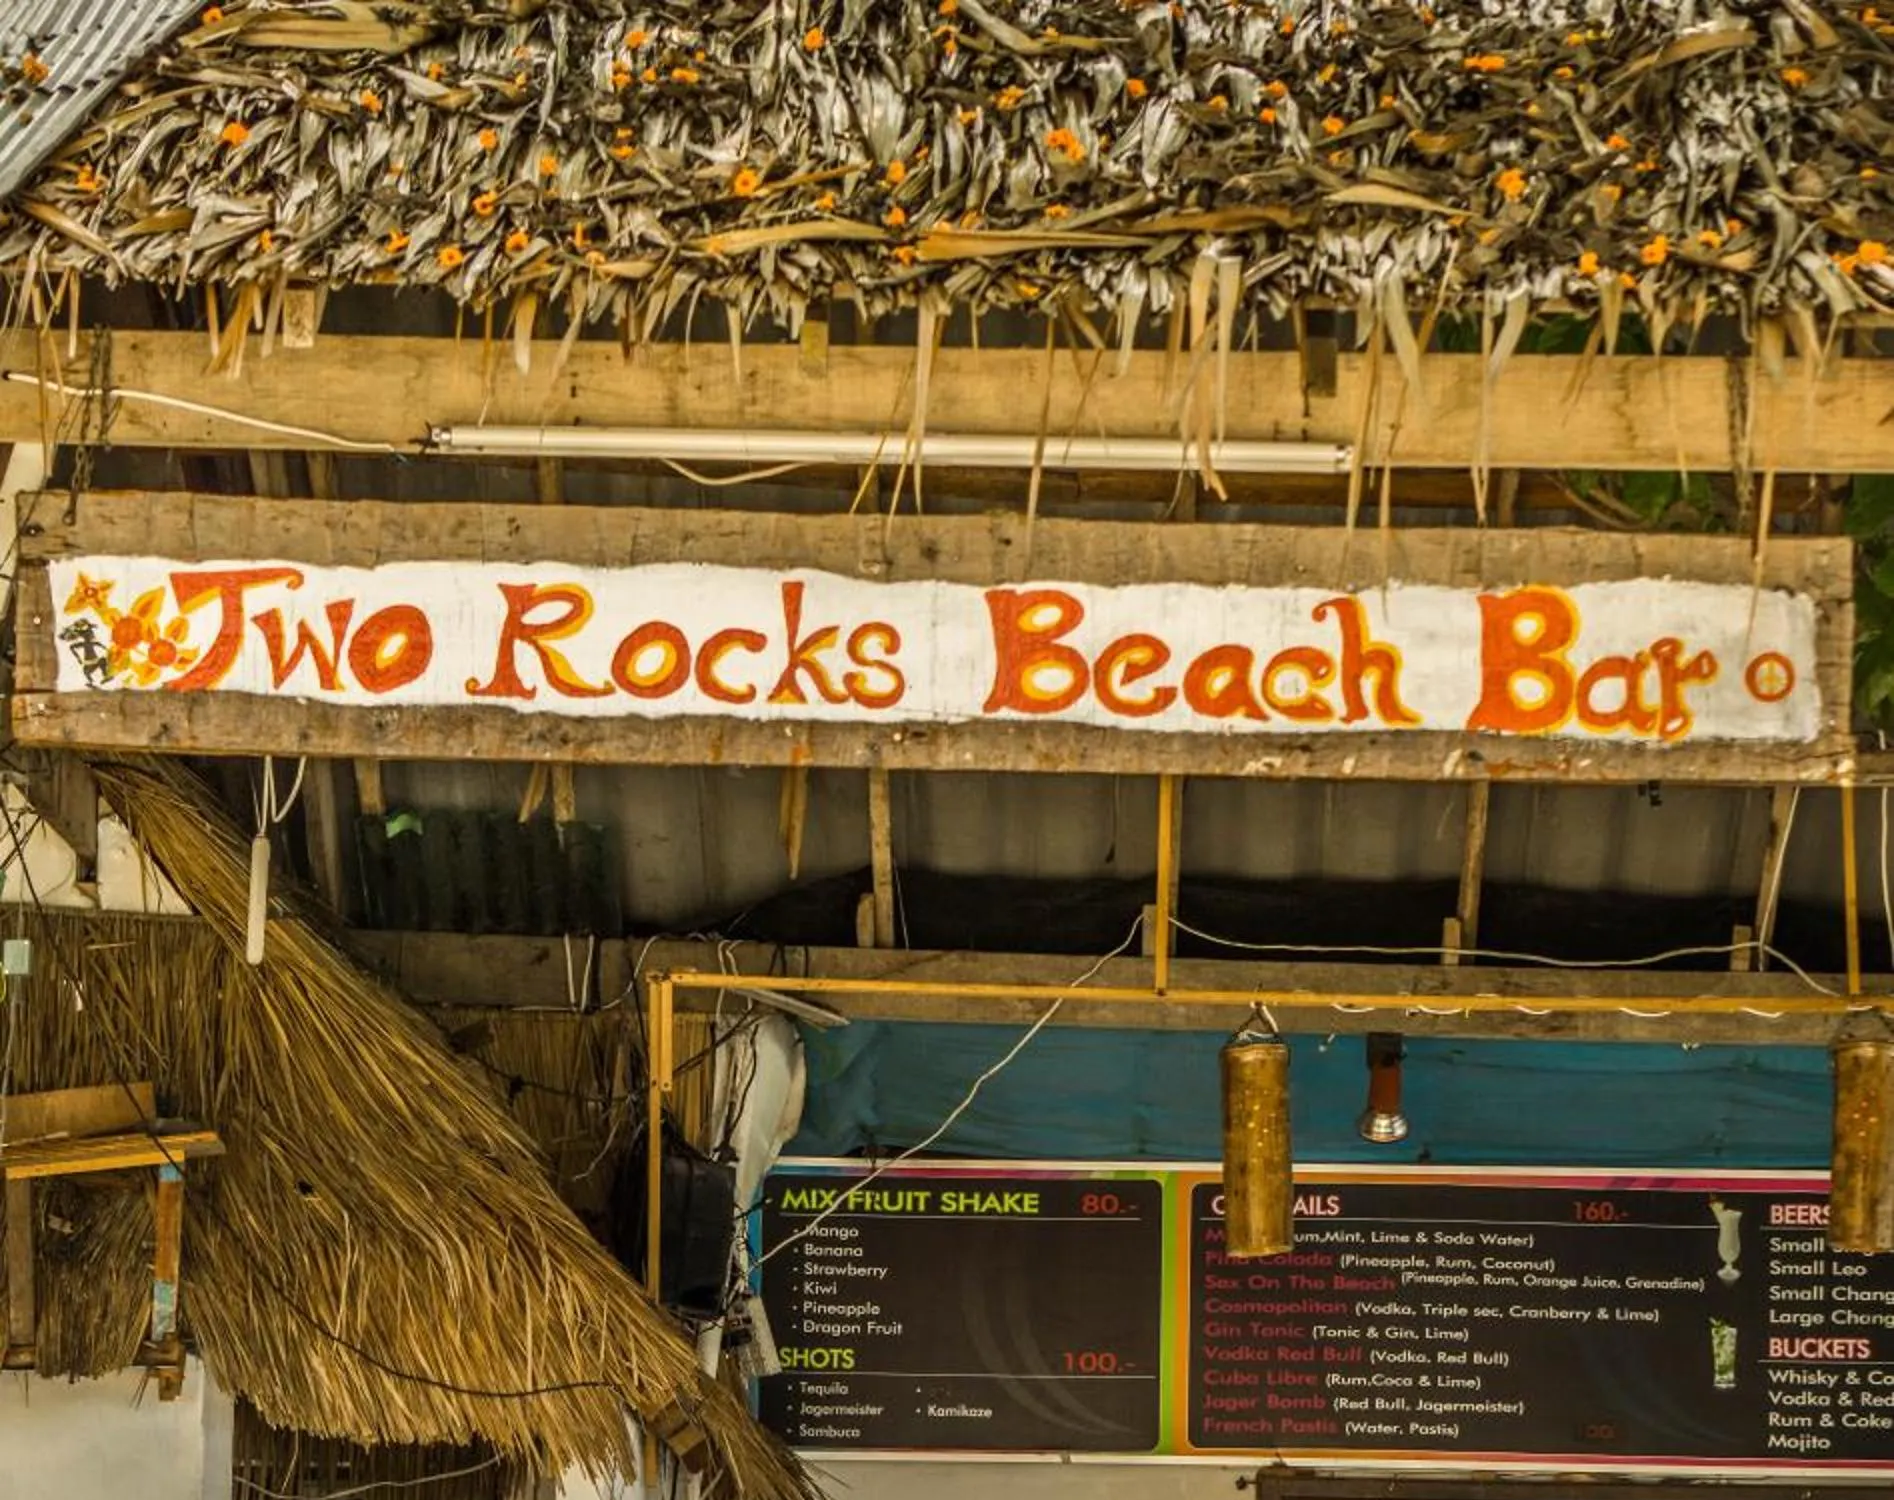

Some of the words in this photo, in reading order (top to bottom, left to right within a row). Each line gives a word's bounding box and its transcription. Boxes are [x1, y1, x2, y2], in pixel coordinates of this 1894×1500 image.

[163, 568, 434, 694] Two
[465, 581, 906, 709] Rocks
[982, 589, 1424, 727] Beach
[1466, 585, 1719, 742] Bar
[781, 1189, 838, 1209] MIX
[847, 1191, 931, 1212] FRUIT
[940, 1192, 1039, 1213] SHAKE
[1211, 1196, 1340, 1215] CAILS
[1770, 1204, 1831, 1225] BEERS
[804, 1226, 859, 1240] Mango
[1371, 1231, 1409, 1243] Lime
[1416, 1231, 1428, 1244] &
[1433, 1232, 1474, 1245] Soda
[1479, 1233, 1535, 1248] Water)
[804, 1243, 864, 1257] Banana
[1769, 1237, 1824, 1253] Small
[803, 1261, 888, 1280] Strawberry
[1482, 1257, 1555, 1272] Coconut)
[1769, 1260, 1824, 1275] Small
[1832, 1261, 1868, 1276] Leo
[803, 1282, 837, 1295] Kiwi
[1205, 1275, 1238, 1289] Sex
[1249, 1275, 1280, 1289] On
[1289, 1275, 1325, 1290] The
[1334, 1275, 1395, 1290] Beach
[1523, 1274, 1577, 1289] Orange
[1625, 1277, 1705, 1292] Grenadine)
[1769, 1285, 1824, 1300] Small
[1831, 1285, 1894, 1304] Chang
[803, 1301, 880, 1316] Pineapple
[1423, 1303, 1468, 1318] Triple
[1509, 1305, 1591, 1321] Cranberry
[1597, 1308, 1609, 1320] &
[1615, 1307, 1660, 1323] Lime)
[1769, 1309, 1824, 1327] Large
[1831, 1309, 1894, 1328] Chang
[803, 1320, 861, 1337] Dragon
[867, 1321, 903, 1335] Fruit
[1204, 1322, 1241, 1337] Gin
[1250, 1322, 1306, 1337] Tonic
[1312, 1325, 1361, 1340] (Tonic
[1366, 1326, 1379, 1339] &
[1425, 1327, 1469, 1343] Lime)
[1203, 1346, 1269, 1361] Vodka
[1277, 1346, 1314, 1361] Red
[1323, 1346, 1362, 1361] Bull
[1437, 1352, 1467, 1364] Red
[1473, 1352, 1510, 1367] Bull)
[1769, 1337, 1871, 1359] BUCKETS
[779, 1348, 855, 1369] SHOTS
[1203, 1370, 1259, 1385] Cuba
[1267, 1370, 1318, 1386] Libre
[1418, 1375, 1430, 1387] &
[1438, 1375, 1481, 1390] Lime)
[1768, 1369, 1839, 1388] Whisky
[1845, 1371, 1861, 1385] &
[800, 1381, 849, 1397] Tequila
[1203, 1394, 1257, 1410] Jager
[1267, 1394, 1326, 1409] Bomb
[1333, 1397, 1368, 1412] (Red
[1416, 1399, 1526, 1415] Jagermeister)
[1768, 1391, 1830, 1406] Vodka
[1837, 1391, 1854, 1406] &
[1861, 1391, 1894, 1407] Red
[800, 1402, 884, 1417] Jagermeister
[927, 1404, 993, 1419] Kamikaze
[1203, 1417, 1272, 1433] French
[1281, 1418, 1338, 1433] Pastis
[1409, 1423, 1459, 1438] Pastis)
[1769, 1412, 1812, 1427] Rum
[1820, 1413, 1834, 1427] &
[1841, 1413, 1893, 1429] Coke
[799, 1424, 861, 1438] Sambuca
[1768, 1434, 1831, 1452] Mojito
